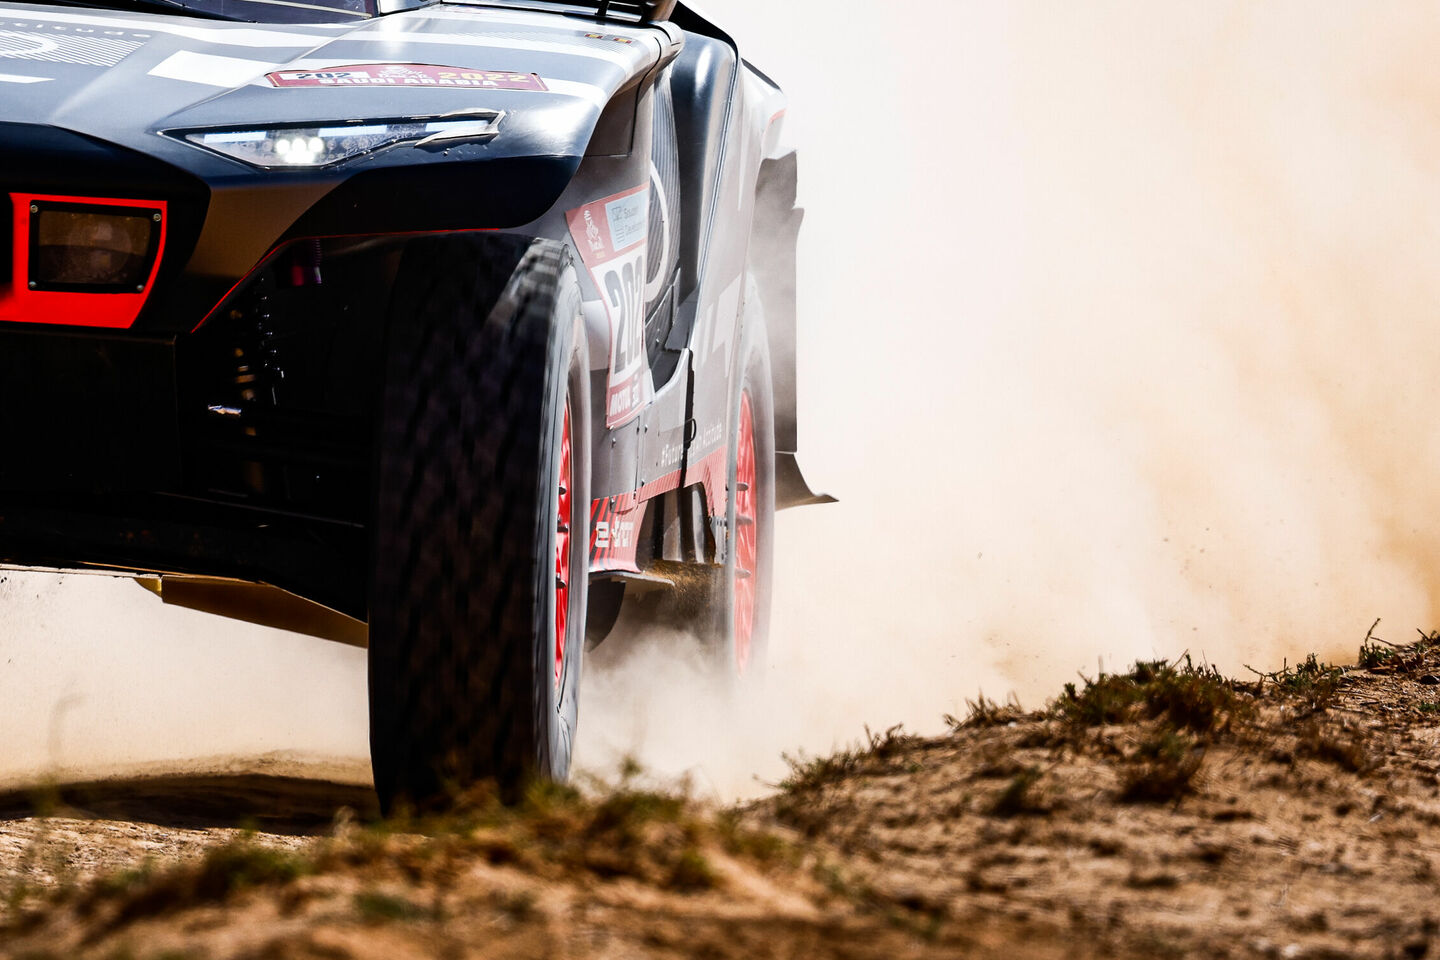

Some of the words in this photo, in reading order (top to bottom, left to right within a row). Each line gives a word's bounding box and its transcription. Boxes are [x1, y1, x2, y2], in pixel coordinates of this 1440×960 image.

[295, 72, 352, 80] 202
[438, 72, 531, 83] 2022
[317, 77, 396, 85] SAUDI
[403, 77, 499, 87] ARABIA
